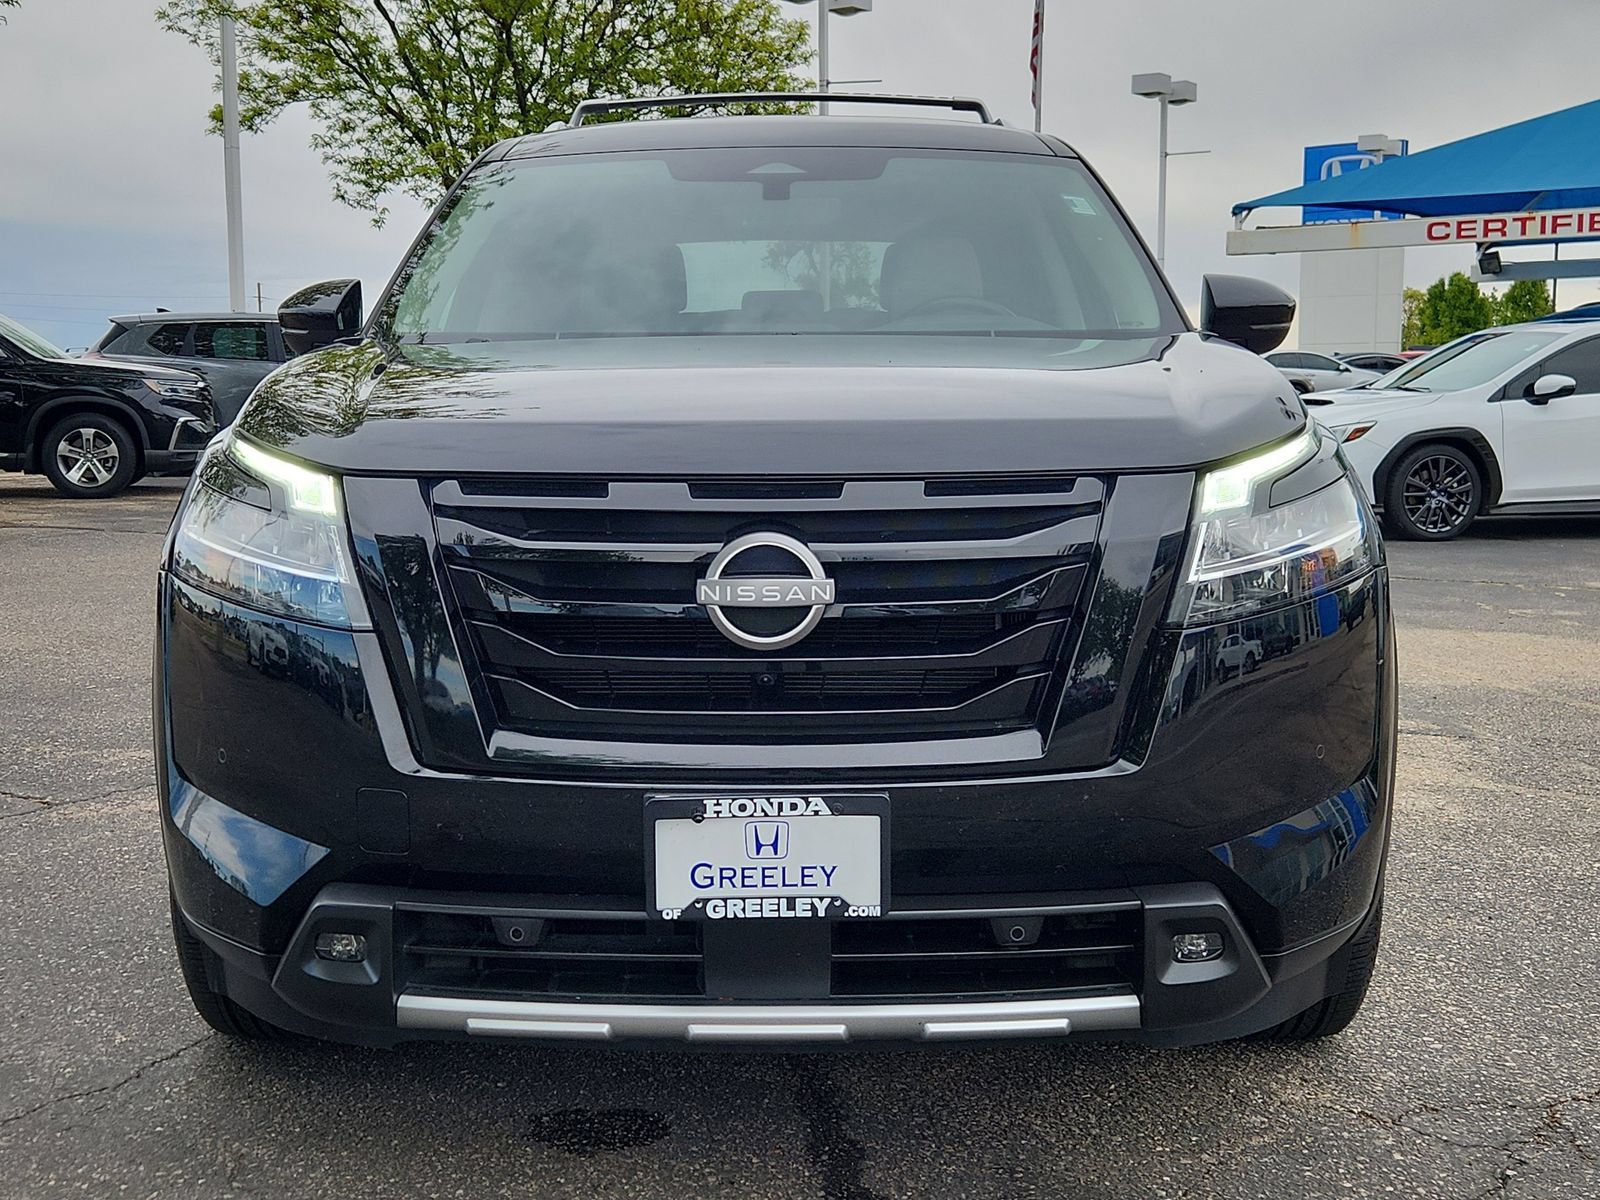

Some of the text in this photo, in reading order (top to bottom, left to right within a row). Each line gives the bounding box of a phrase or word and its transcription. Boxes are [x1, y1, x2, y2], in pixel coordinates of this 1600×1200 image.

[700, 585, 830, 601] NISSAN
[703, 797, 832, 818] HONDA
[690, 863, 838, 889] GREELEY
[662, 898, 881, 920] OF GREELEY .COM
